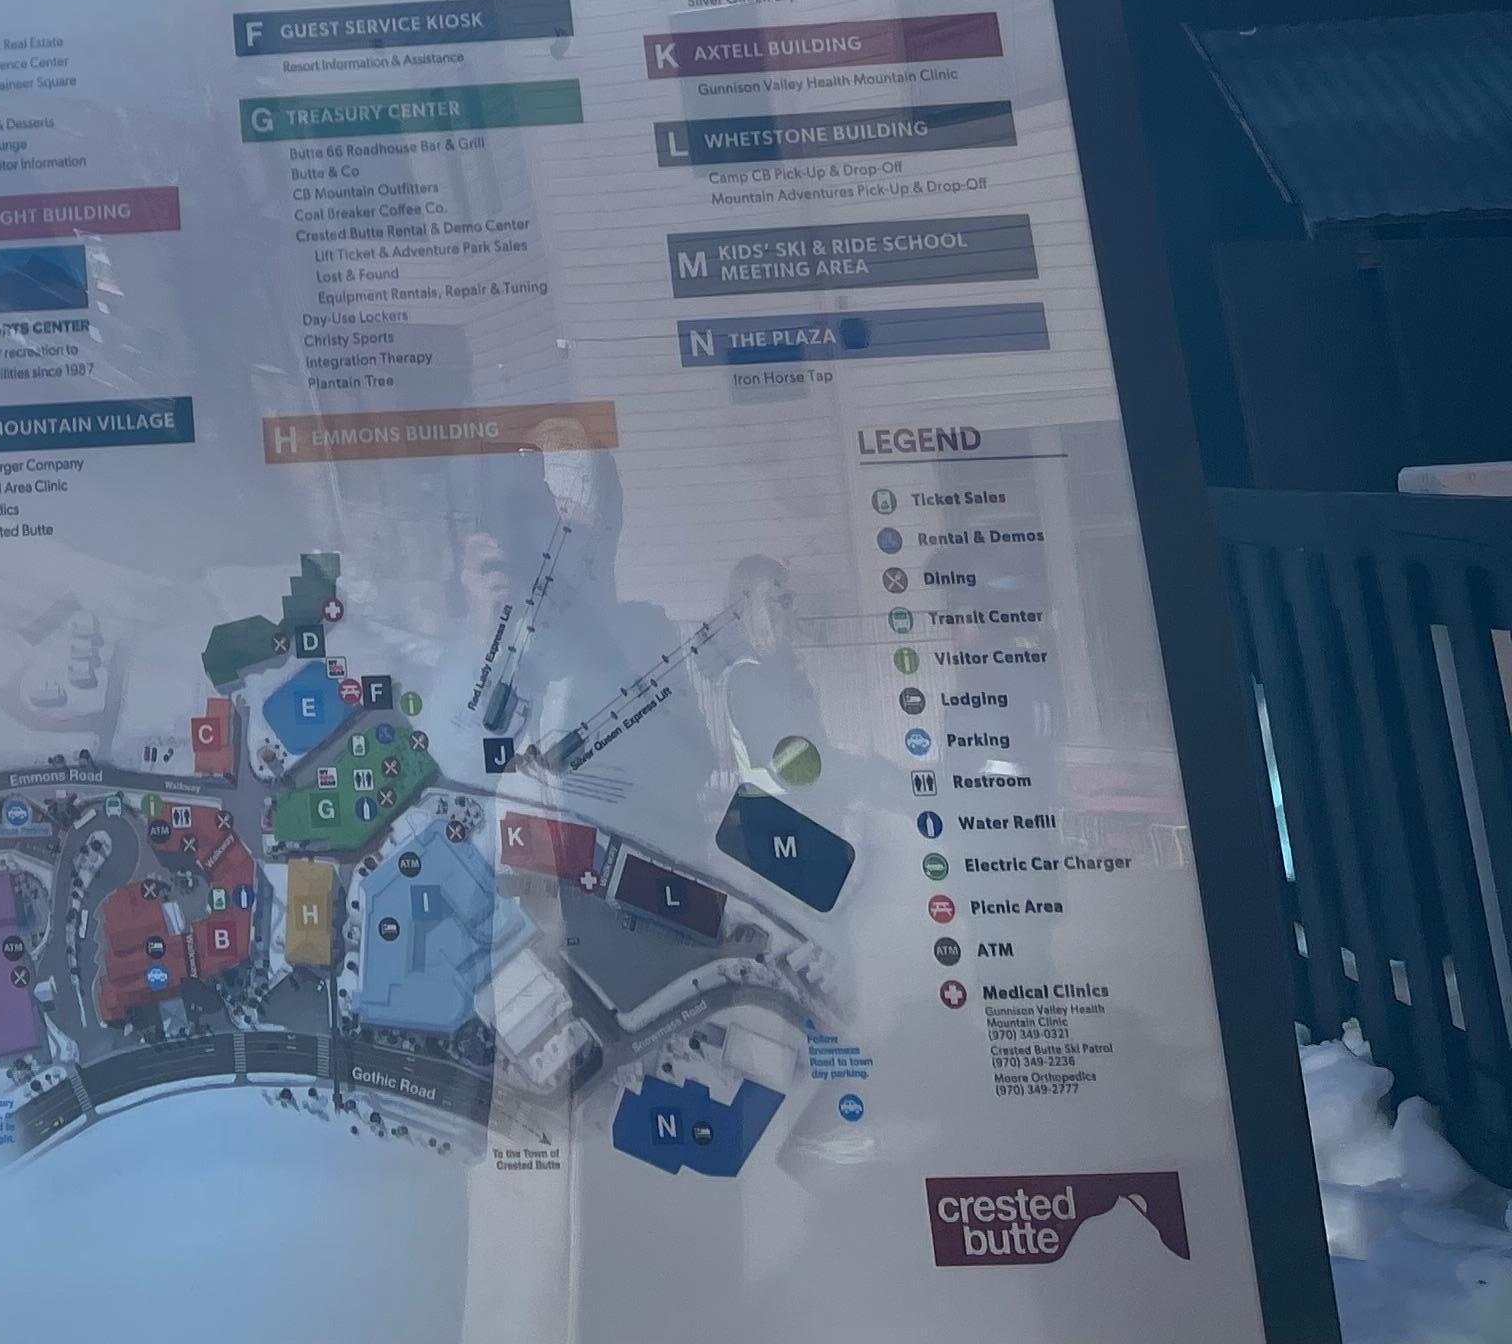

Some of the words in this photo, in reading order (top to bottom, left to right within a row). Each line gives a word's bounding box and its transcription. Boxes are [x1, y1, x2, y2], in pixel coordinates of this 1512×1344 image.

[246, 22, 263, 46] F
[280, 21, 339, 40] GUEST
[345, 15, 421, 35] SERVICE
[426, 12, 484, 30] KIOSK
[655, 43, 678, 68] K
[693, 42, 763, 61] AXTELL
[768, 35, 862, 56] BUILDING
[250, 107, 273, 132] G
[286, 105, 380, 126] TREASURY
[388, 100, 461, 120] CENTER
[669, 132, 687, 156] L
[704, 127, 826, 149] WHETSTONE
[833, 120, 929, 141] BUILDING
[43, 202, 131, 223] BUILDING
[678, 252, 708, 279] M
[774, 241, 806, 258] SKI
[812, 241, 826, 255] &
[831, 238, 877, 254] RIDE
[882, 233, 967, 253] SCHOOL
[316, 270, 342, 283] Lost
[346, 269, 355, 281] &
[359, 267, 399, 281] Found
[720, 262, 810, 282] MEETING
[815, 259, 869, 275] AREA
[33, 317, 90, 334] CENTER
[359, 309, 408, 324] Lockers
[690, 330, 714, 356] N
[728, 332, 766, 349] THE
[773, 328, 836, 347] PLAZA
[308, 375, 361, 391] Plantain
[364, 374, 394, 388] Tree
[733, 374, 761, 387] Iron
[763, 371, 803, 386] Horse
[806, 370, 833, 385] Tap
[97, 411, 173, 431] VILLAGE
[275, 426, 297, 453] H
[312, 426, 399, 447] EMMONS
[406, 421, 499, 442] BUILDING
[857, 423, 983, 457] LEGEND
[911, 490, 961, 508] Ticket
[963, 489, 1006, 505] Sales
[22, 523, 53, 537] Butte
[917, 530, 968, 547] Rental
[972, 530, 986, 544] &
[989, 527, 1045, 544] Demos
[922, 569, 977, 589] Dining
[928, 610, 986, 627] Transit
[988, 608, 1043, 624] Center
[303, 633, 318, 650] D
[934, 649, 989, 667] Visitor
[992, 648, 1048, 665] Center
[370, 683, 384, 702] F
[940, 689, 1009, 711] Lodging
[301, 697, 316, 717] E
[198, 725, 214, 744] C
[946, 730, 1010, 752] Parking
[494, 745, 506, 765] J
[10, 771, 66, 786] Emmons
[69, 769, 103, 783] Road
[952, 771, 1032, 791] Restroom
[317, 799, 335, 819] G
[958, 814, 1011, 833] Water
[1013, 813, 1057, 831] Refill
[507, 826, 524, 847] K
[773, 835, 797, 858] M
[964, 855, 1028, 875] Electric
[1030, 855, 1061, 872] Car
[1063, 852, 1133, 874] Charger
[665, 886, 680, 906] L
[302, 904, 319, 924] H
[970, 898, 1021, 916] Picnic
[1023, 897, 1064, 915] Area
[214, 929, 230, 949] B
[975, 941, 1014, 959] ATM
[981, 983, 1049, 1003] Medical
[1052, 981, 1110, 1000] Clinics
[351, 1064, 397, 1091] Gothic
[399, 1076, 436, 1101] Road
[657, 1114, 677, 1137] N
[936, 1186, 1077, 1225] crested
[963, 1221, 1062, 1257] butte
